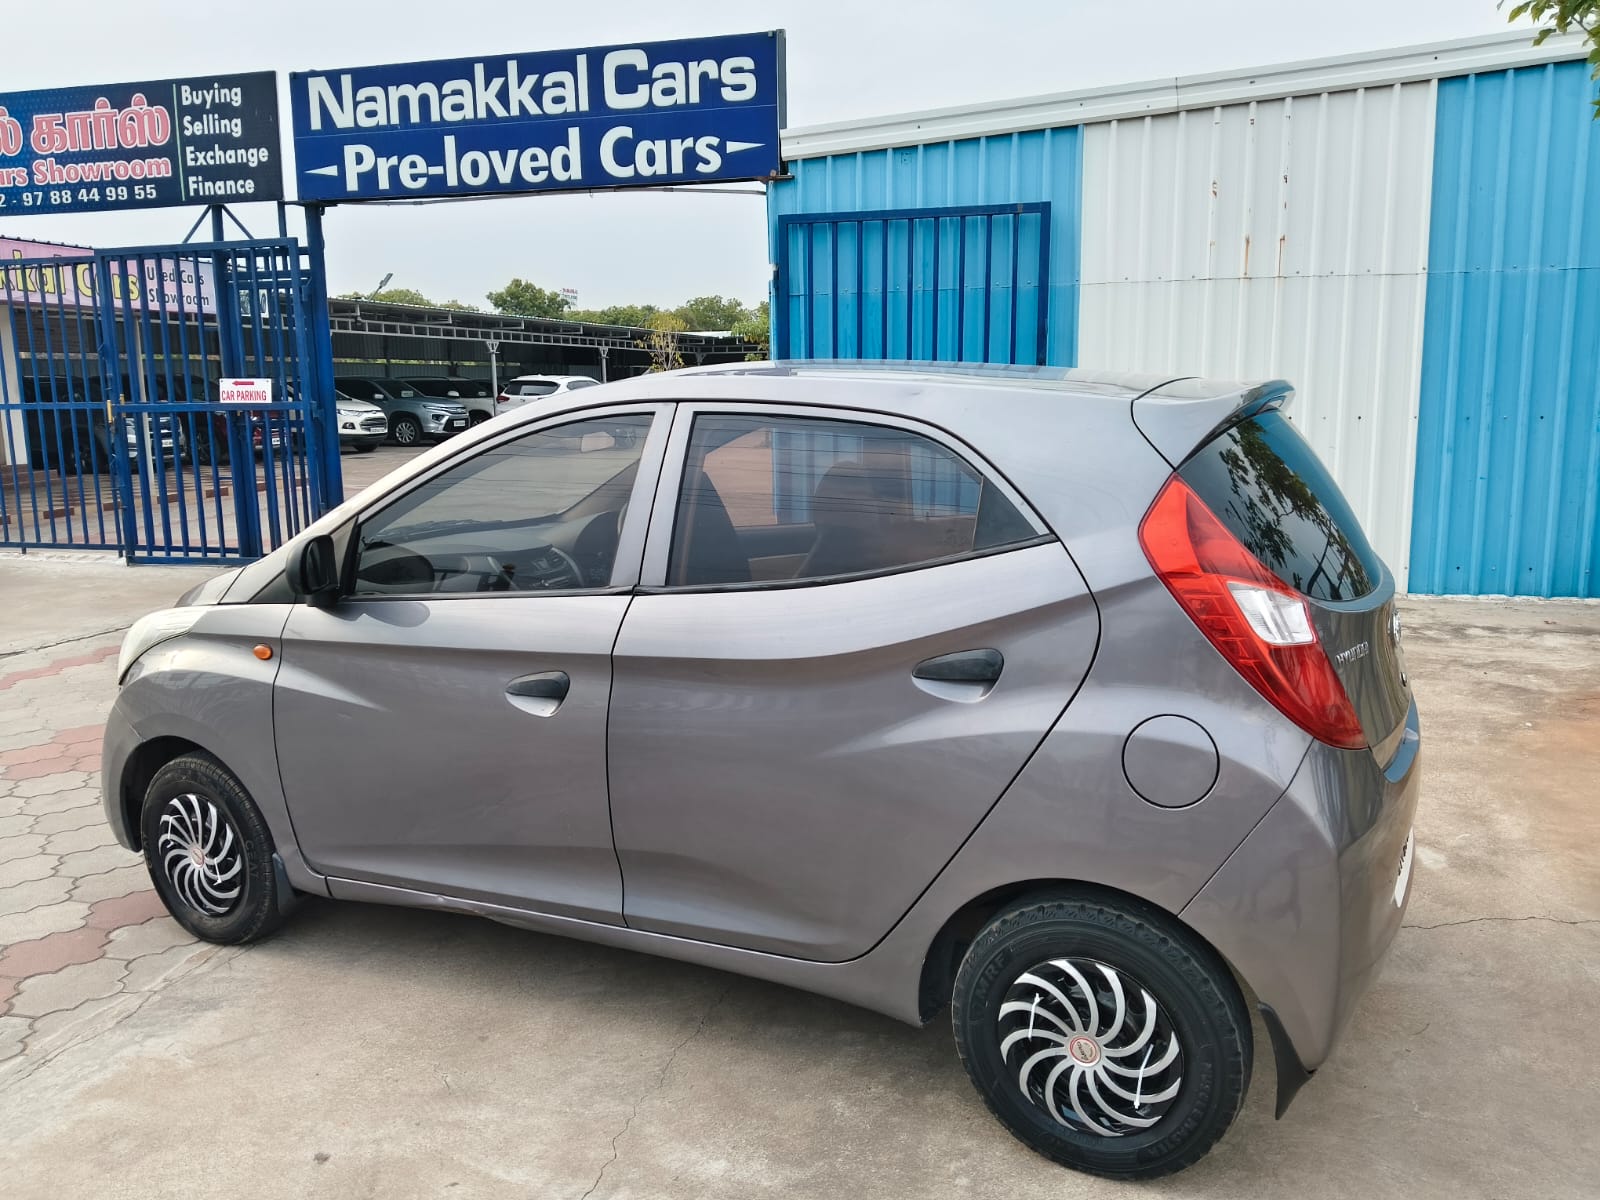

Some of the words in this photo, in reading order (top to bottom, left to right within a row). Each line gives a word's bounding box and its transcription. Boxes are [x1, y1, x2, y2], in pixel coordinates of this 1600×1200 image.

[181, 82, 242, 109] Buying
[307, 54, 590, 131] Namakkal
[603, 48, 757, 110] Cars
[31, 93, 171, 154] கார்ஸ்
[183, 115, 242, 137] Selling
[186, 144, 269, 168] Exchange
[343, 126, 583, 192] Pre-loved
[599, 126, 722, 178] Cars
[33, 157, 172, 187] Showroom
[23, 191, 43, 206] 97
[50, 189, 72, 204] 88
[78, 187, 100, 202] 44
[106, 186, 128, 200] 99
[135, 184, 157, 199] 55
[188, 176, 255, 196] Finance
[180, 269, 205, 286] Cas
[221, 390, 235, 401] CAR
[236, 390, 267, 401] PARKING
